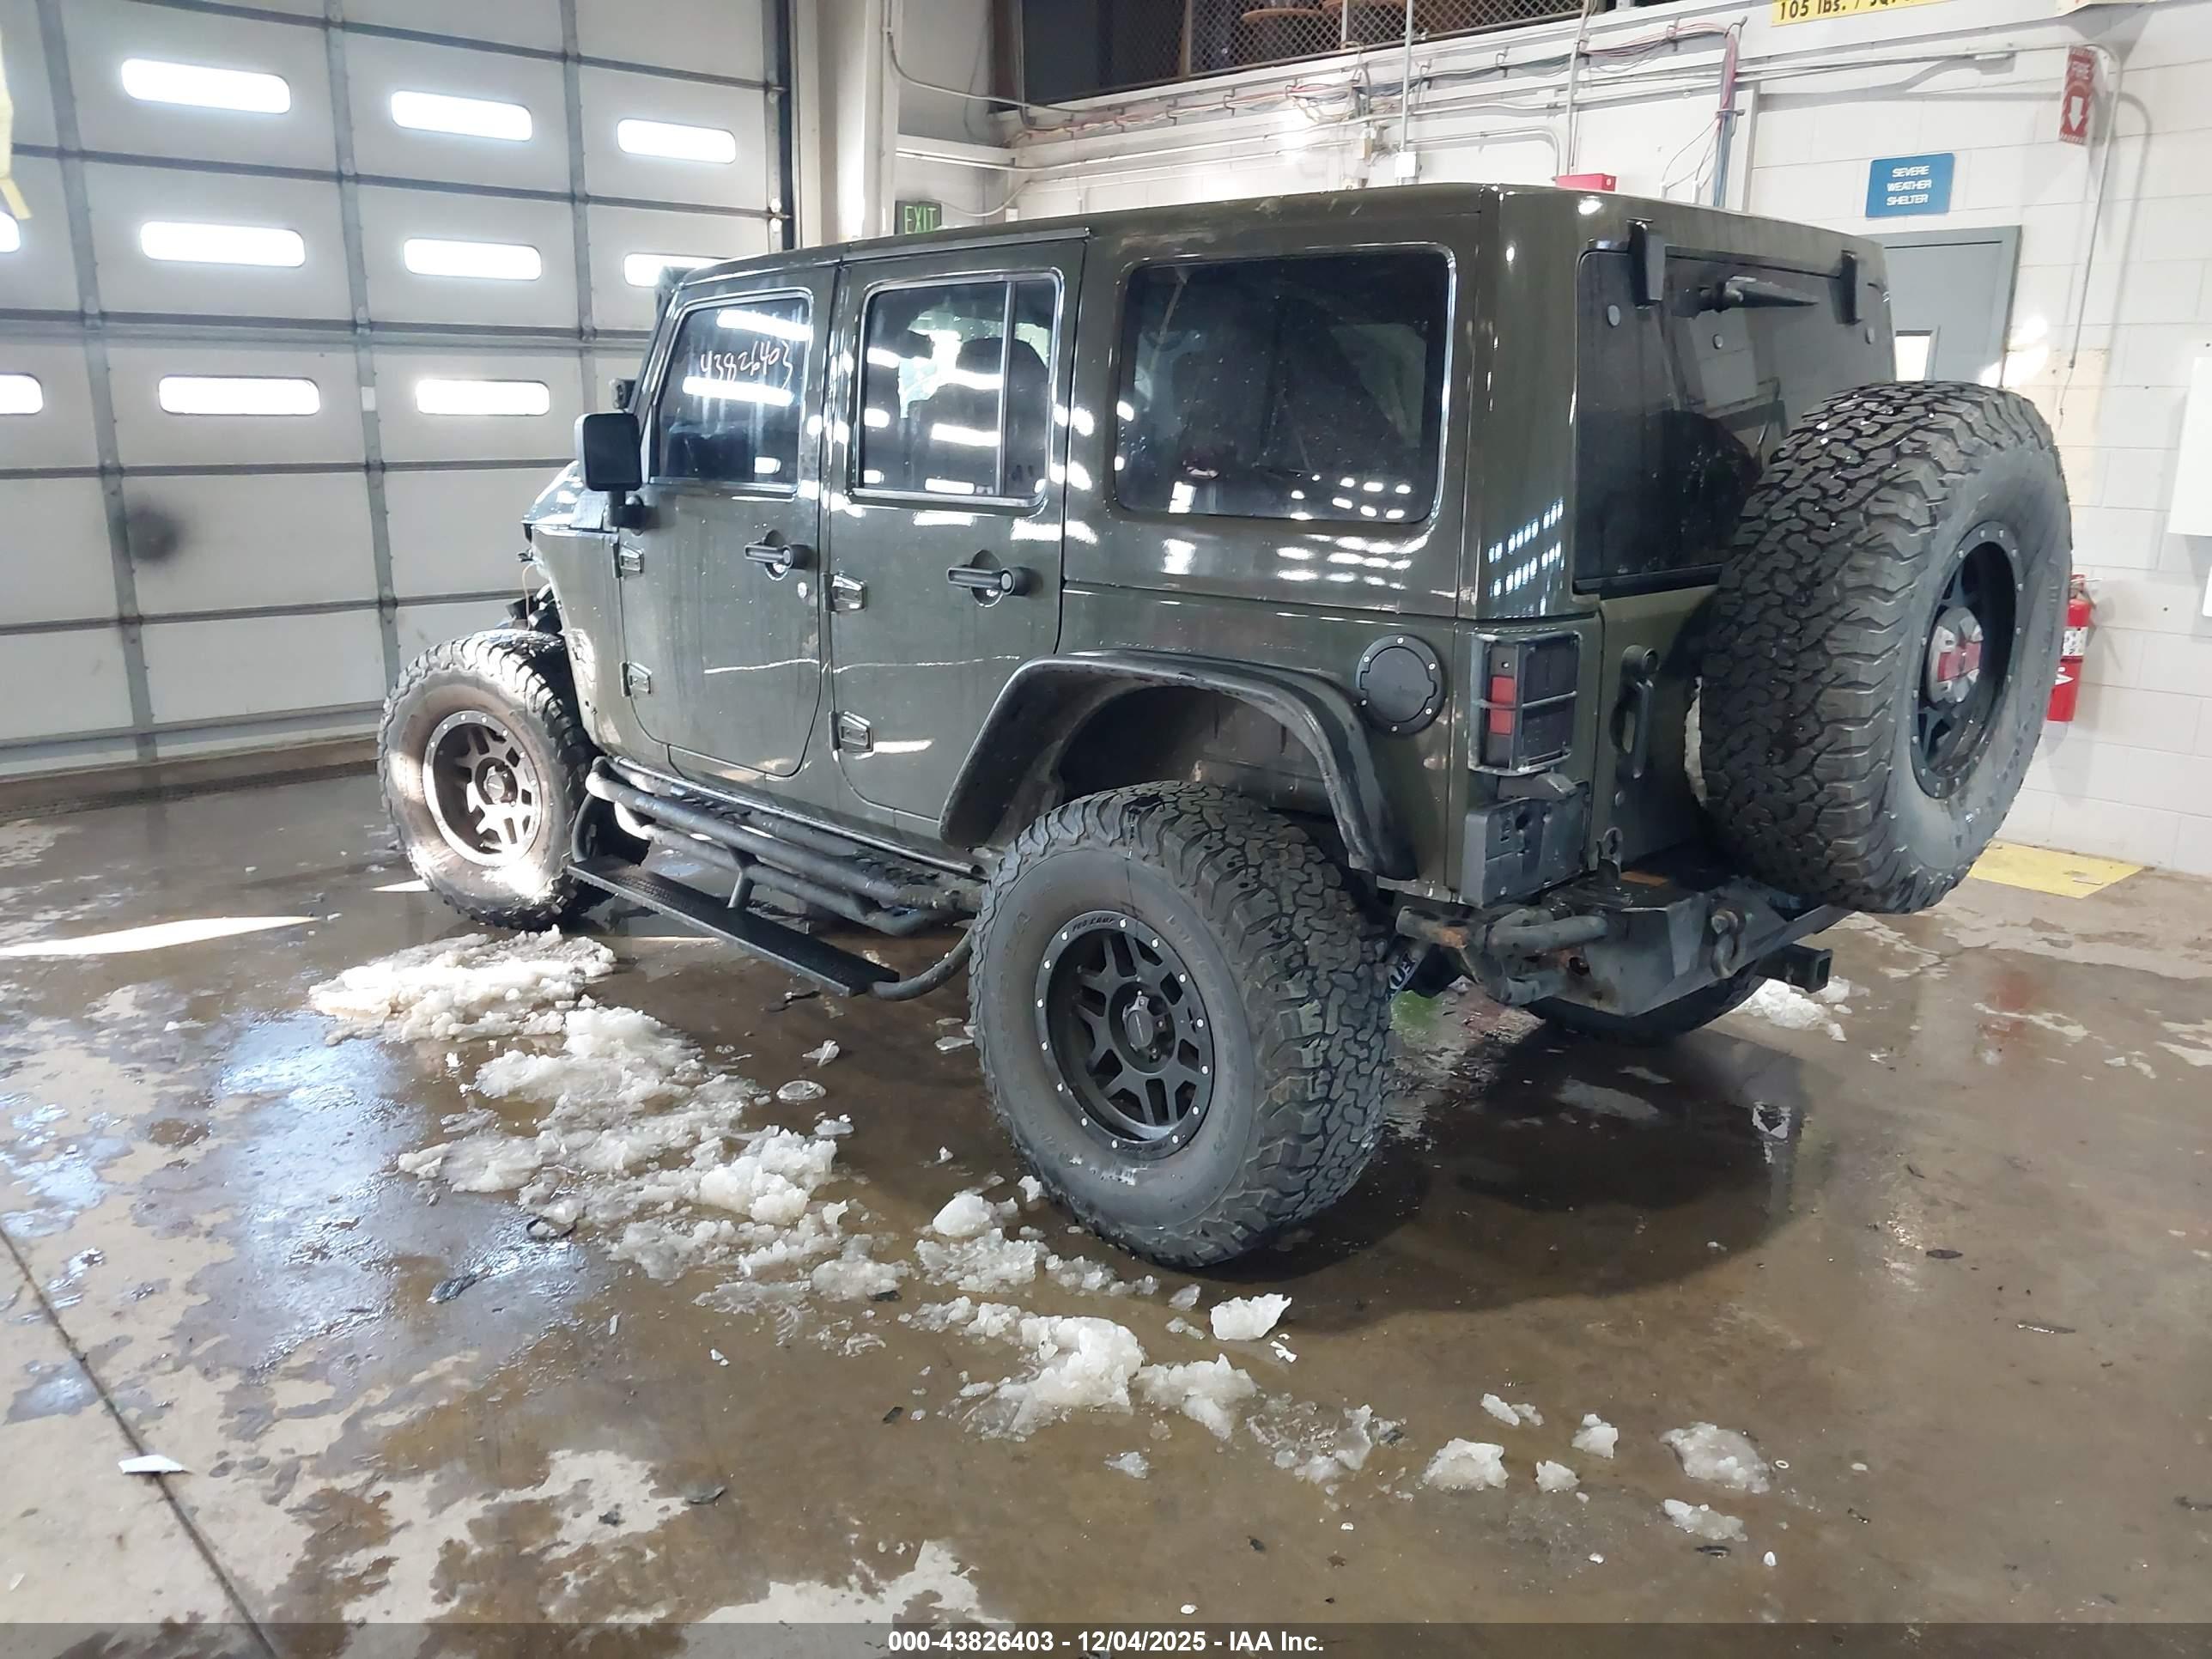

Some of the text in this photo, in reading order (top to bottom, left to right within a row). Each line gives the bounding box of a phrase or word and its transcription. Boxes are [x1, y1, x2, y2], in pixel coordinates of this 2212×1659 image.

[1780, 0, 1808, 20] 105
[1892, 165, 1930, 178] SEVERE
[1887, 179, 1932, 192] WEATHER
[1886, 193, 1929, 206] SHELTER
[904, 205, 938, 234] EXIT
[700, 340, 793, 390] 43826403
